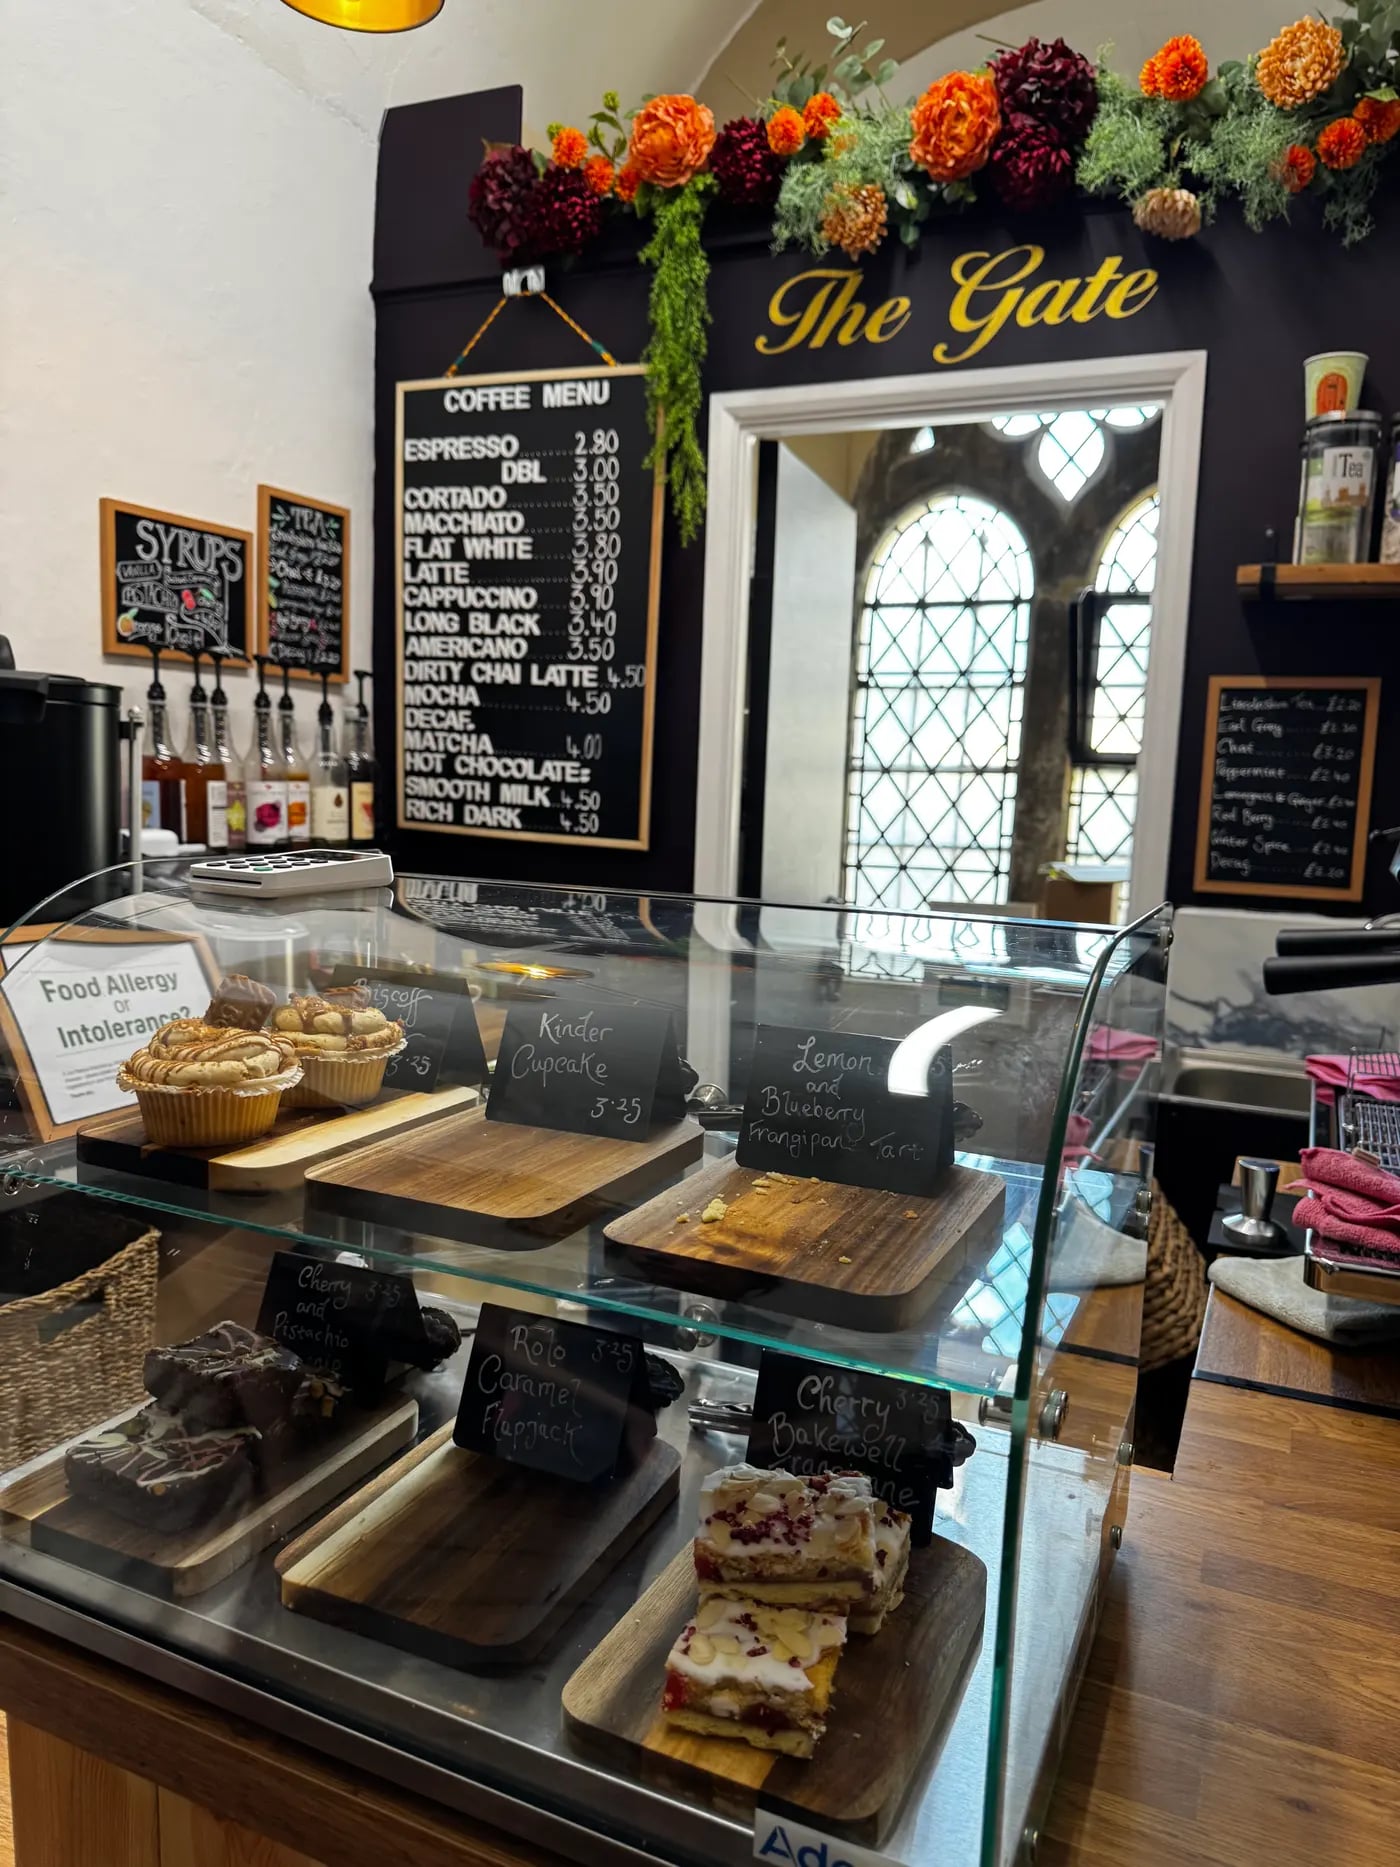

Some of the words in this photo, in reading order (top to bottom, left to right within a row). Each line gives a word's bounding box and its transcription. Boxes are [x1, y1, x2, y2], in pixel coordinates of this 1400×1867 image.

[754, 268, 913, 355] The
[932, 244, 1160, 365] Gate
[443, 385, 531, 413] COFFEE
[542, 379, 610, 407] MENU
[404, 434, 520, 461] ESPRESSO
[574, 429, 619, 456] 2.80
[501, 460, 548, 484] DBL
[572, 456, 620, 482] 3.00
[1338, 453, 1363, 478] Tea
[404, 485, 507, 509] CORTADO
[572, 481, 620, 507] 3.50
[404, 511, 525, 535] MACCHIATO
[572, 506, 621, 532] 3.50
[135, 519, 243, 582] SYRUPS
[404, 537, 455, 560] FLAT
[463, 536, 534, 560] WHITE
[571, 532, 622, 559] 3.80
[404, 562, 470, 583] LATTE
[571, 559, 618, 585] 3.90
[404, 586, 538, 609] CAPPUCCINO
[569, 583, 614, 610] 3.90
[405, 611, 460, 633] LONG
[469, 612, 541, 636] BLACK
[568, 610, 617, 637] 3.40
[406, 635, 528, 659] AMERICANO
[567, 636, 615, 661] 3.50
[404, 661, 463, 683] DIRTY
[471, 662, 522, 684] CHAI
[530, 663, 598, 687] LATTE
[404, 685, 480, 707] MOCHA
[566, 690, 611, 714] 4.50
[404, 730, 494, 755] MATCHA
[406, 752, 446, 773] HOT
[405, 776, 491, 802] SMOOTH
[500, 784, 550, 807] MILK
[560, 789, 601, 811] 4.50
[406, 800, 454, 822] RICH
[463, 803, 522, 829] DARK
[560, 812, 599, 833] 4.50
[39, 976, 101, 1002] Food
[106, 972, 178, 996] Allergy
[114, 998, 131, 1014] or
[539, 1011, 614, 1044] Kinder
[511, 1044, 609, 1087] Cupcake
[793, 1036, 875, 1076] Lemon
[806, 1073, 843, 1100] and
[761, 1085, 865, 1142] Blueberry
[749, 1119, 852, 1158] Frangipan
[298, 1264, 352, 1310] Cherry
[296, 1297, 331, 1320] and
[273, 1310, 349, 1348] Pistachio
[510, 1324, 566, 1367] Rolo
[478, 1354, 583, 1418] Caramel
[797, 1375, 891, 1444] Cherry
[482, 1401, 584, 1466] Flapjack
[768, 1411, 907, 1472] Bakewell
